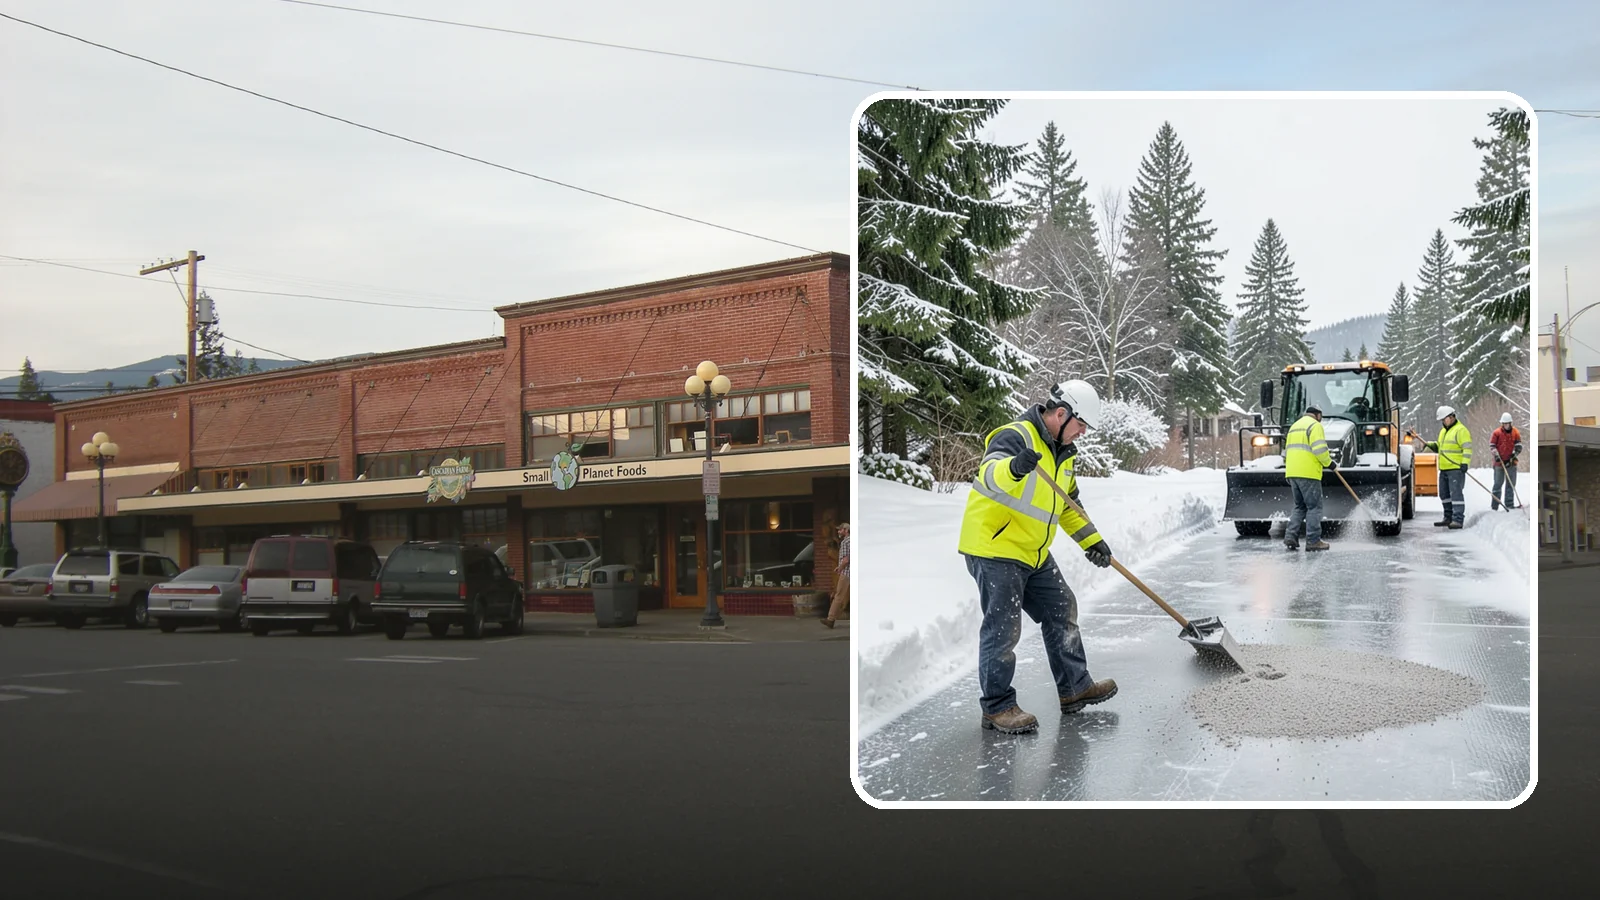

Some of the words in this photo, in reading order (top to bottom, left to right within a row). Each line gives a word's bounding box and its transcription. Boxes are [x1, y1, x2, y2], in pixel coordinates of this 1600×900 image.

[523, 470, 549, 484] Small
[583, 467, 614, 480] Planet
[616, 464, 647, 477] Foods
